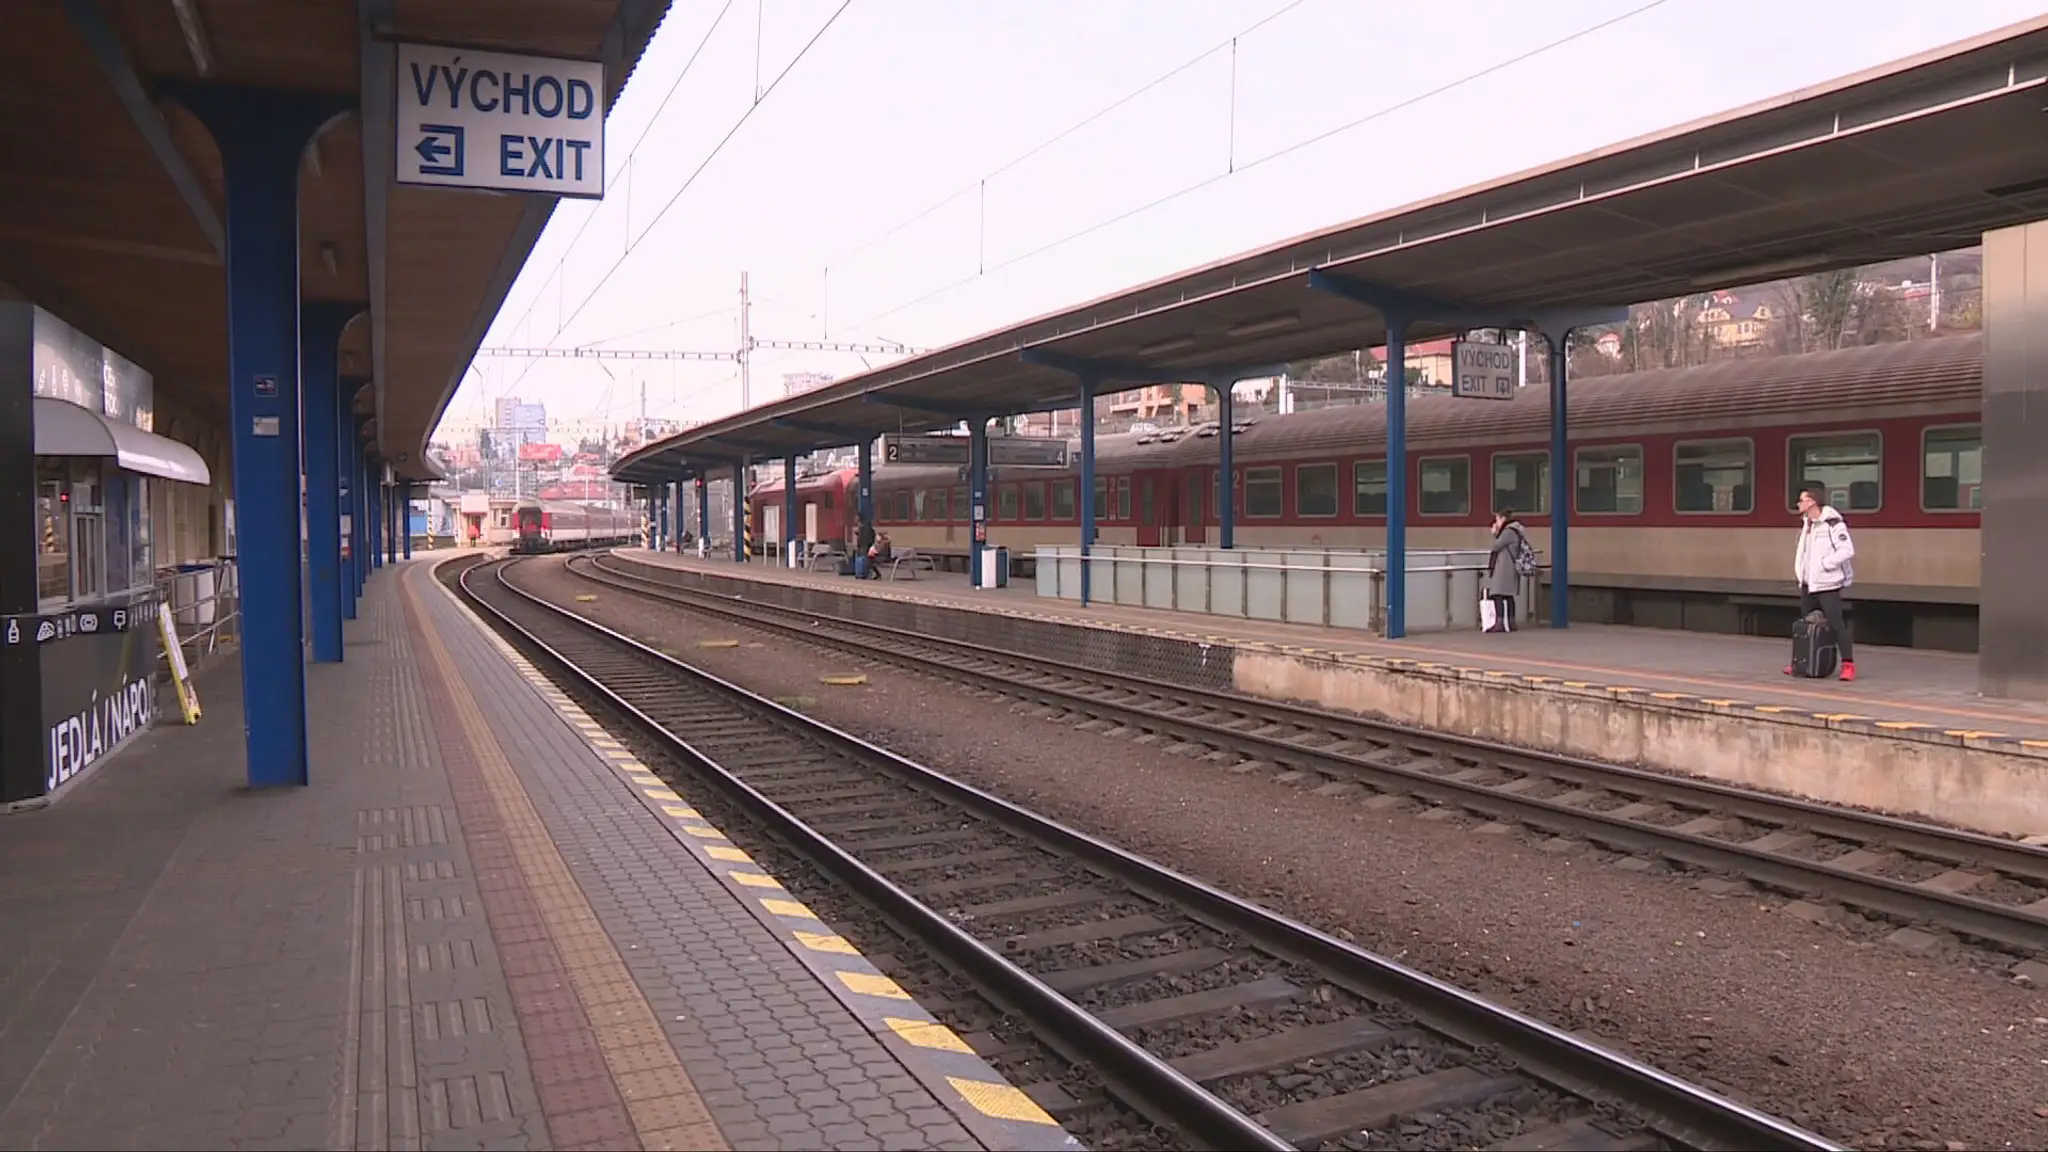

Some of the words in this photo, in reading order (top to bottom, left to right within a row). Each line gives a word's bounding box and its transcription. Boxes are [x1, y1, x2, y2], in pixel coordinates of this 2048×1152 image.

[410, 56, 594, 120] VÝCHOD
[501, 134, 592, 181] EXIT
[1460, 345, 1510, 369] VÝCHOD
[1461, 374, 1487, 393] EXIT
[889, 446, 898, 461] 2
[1232, 470, 1240, 489] 2
